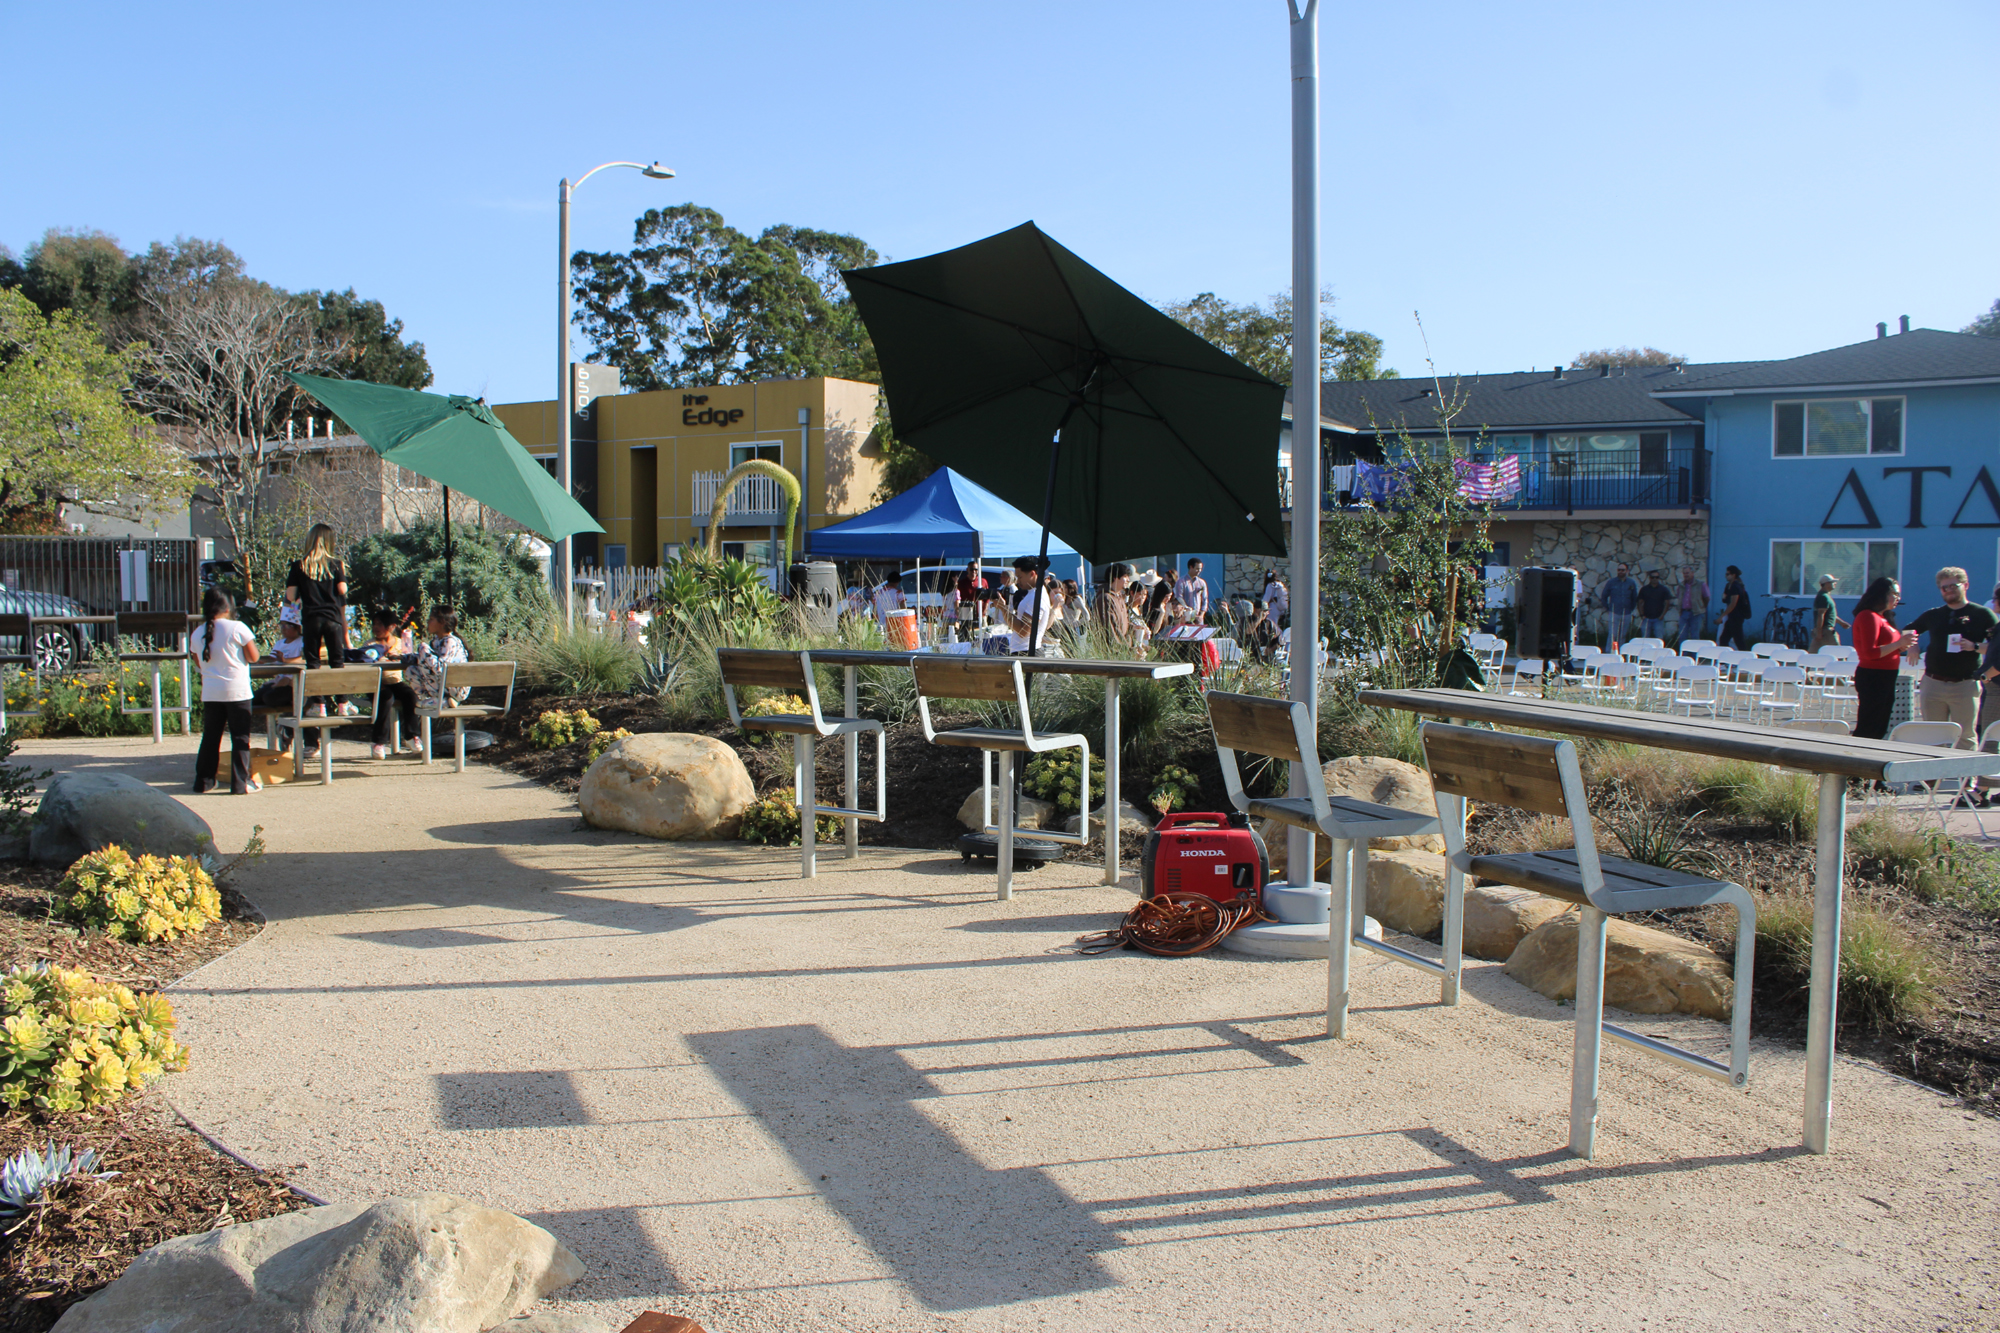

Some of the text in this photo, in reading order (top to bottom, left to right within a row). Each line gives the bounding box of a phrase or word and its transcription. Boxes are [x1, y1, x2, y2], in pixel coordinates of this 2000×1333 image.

[578, 367, 590, 421] 6509
[682, 394, 709, 406] the
[682, 407, 744, 427] Edge
[1180, 850, 1226, 858] HONDA
